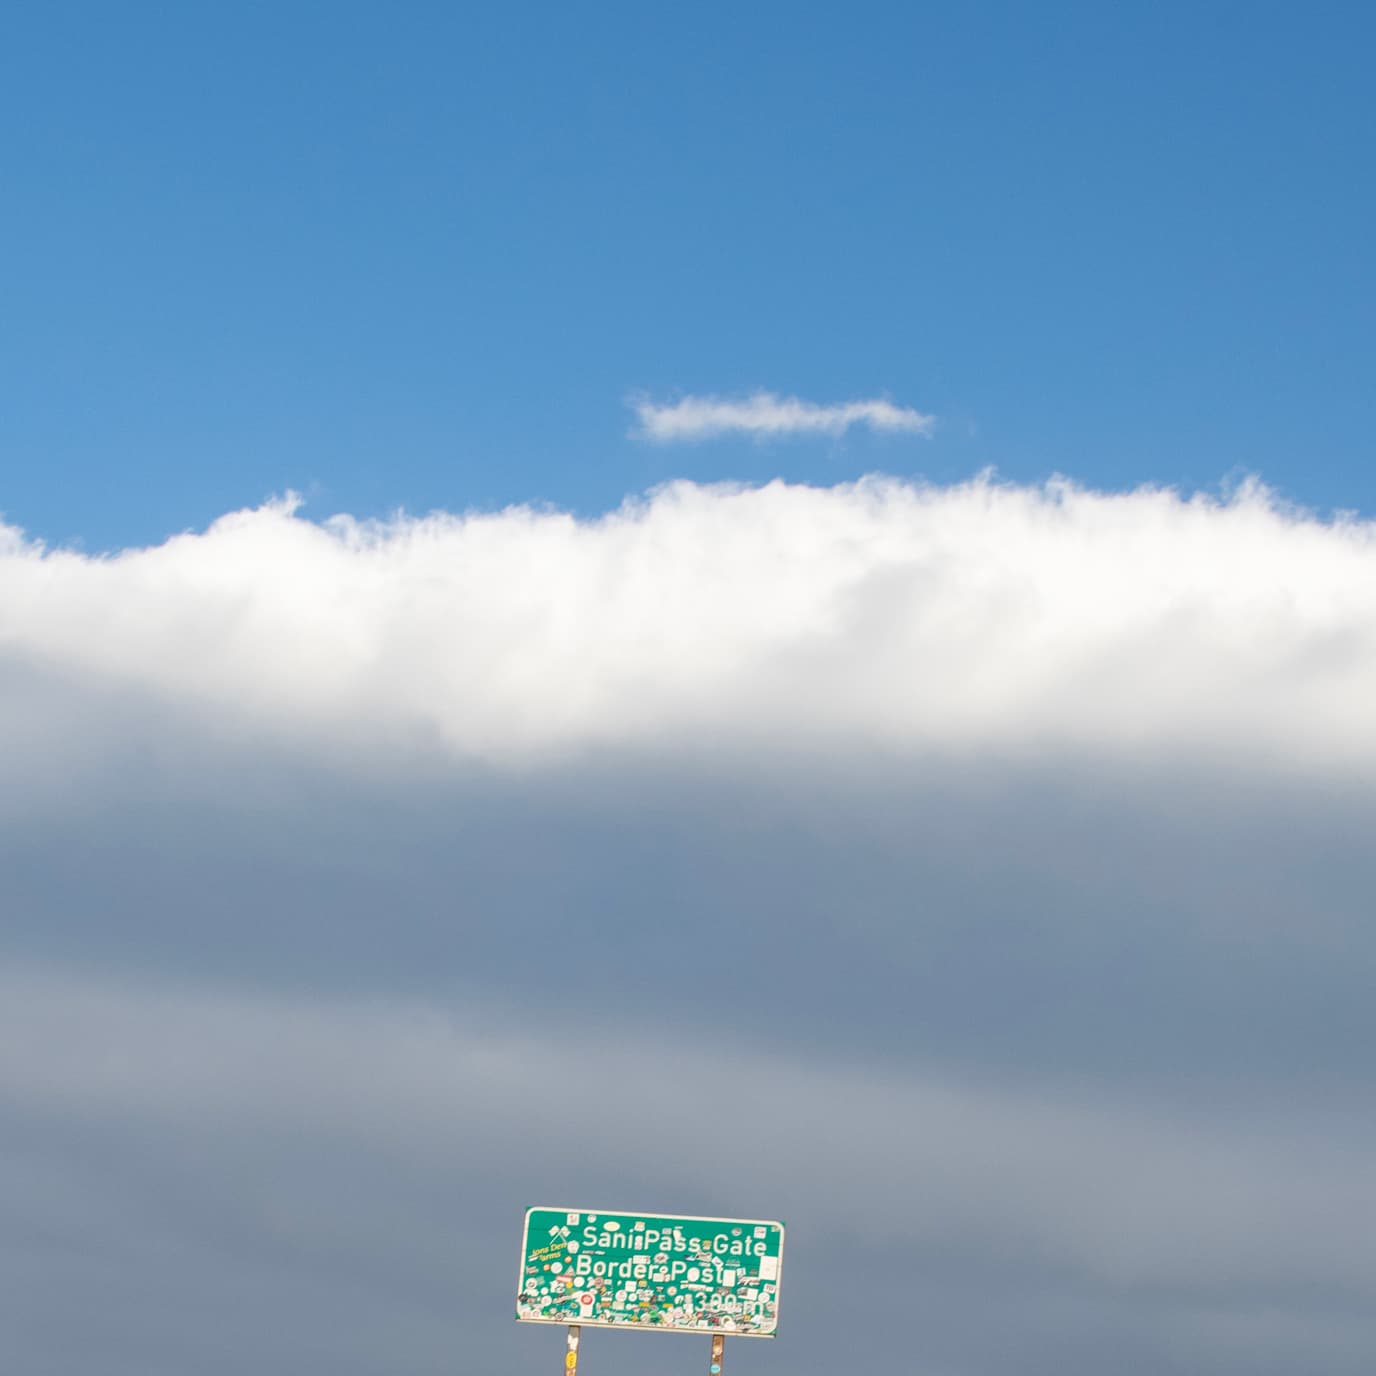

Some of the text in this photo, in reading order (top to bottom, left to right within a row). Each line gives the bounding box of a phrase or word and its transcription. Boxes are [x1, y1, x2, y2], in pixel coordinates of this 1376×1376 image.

[582, 1226, 634, 1249] Sani
[644, 1230, 700, 1253] Pass
[713, 1234, 767, 1257] Gate
[576, 1254, 659, 1280] Border
[671, 1261, 725, 1284] Pst
